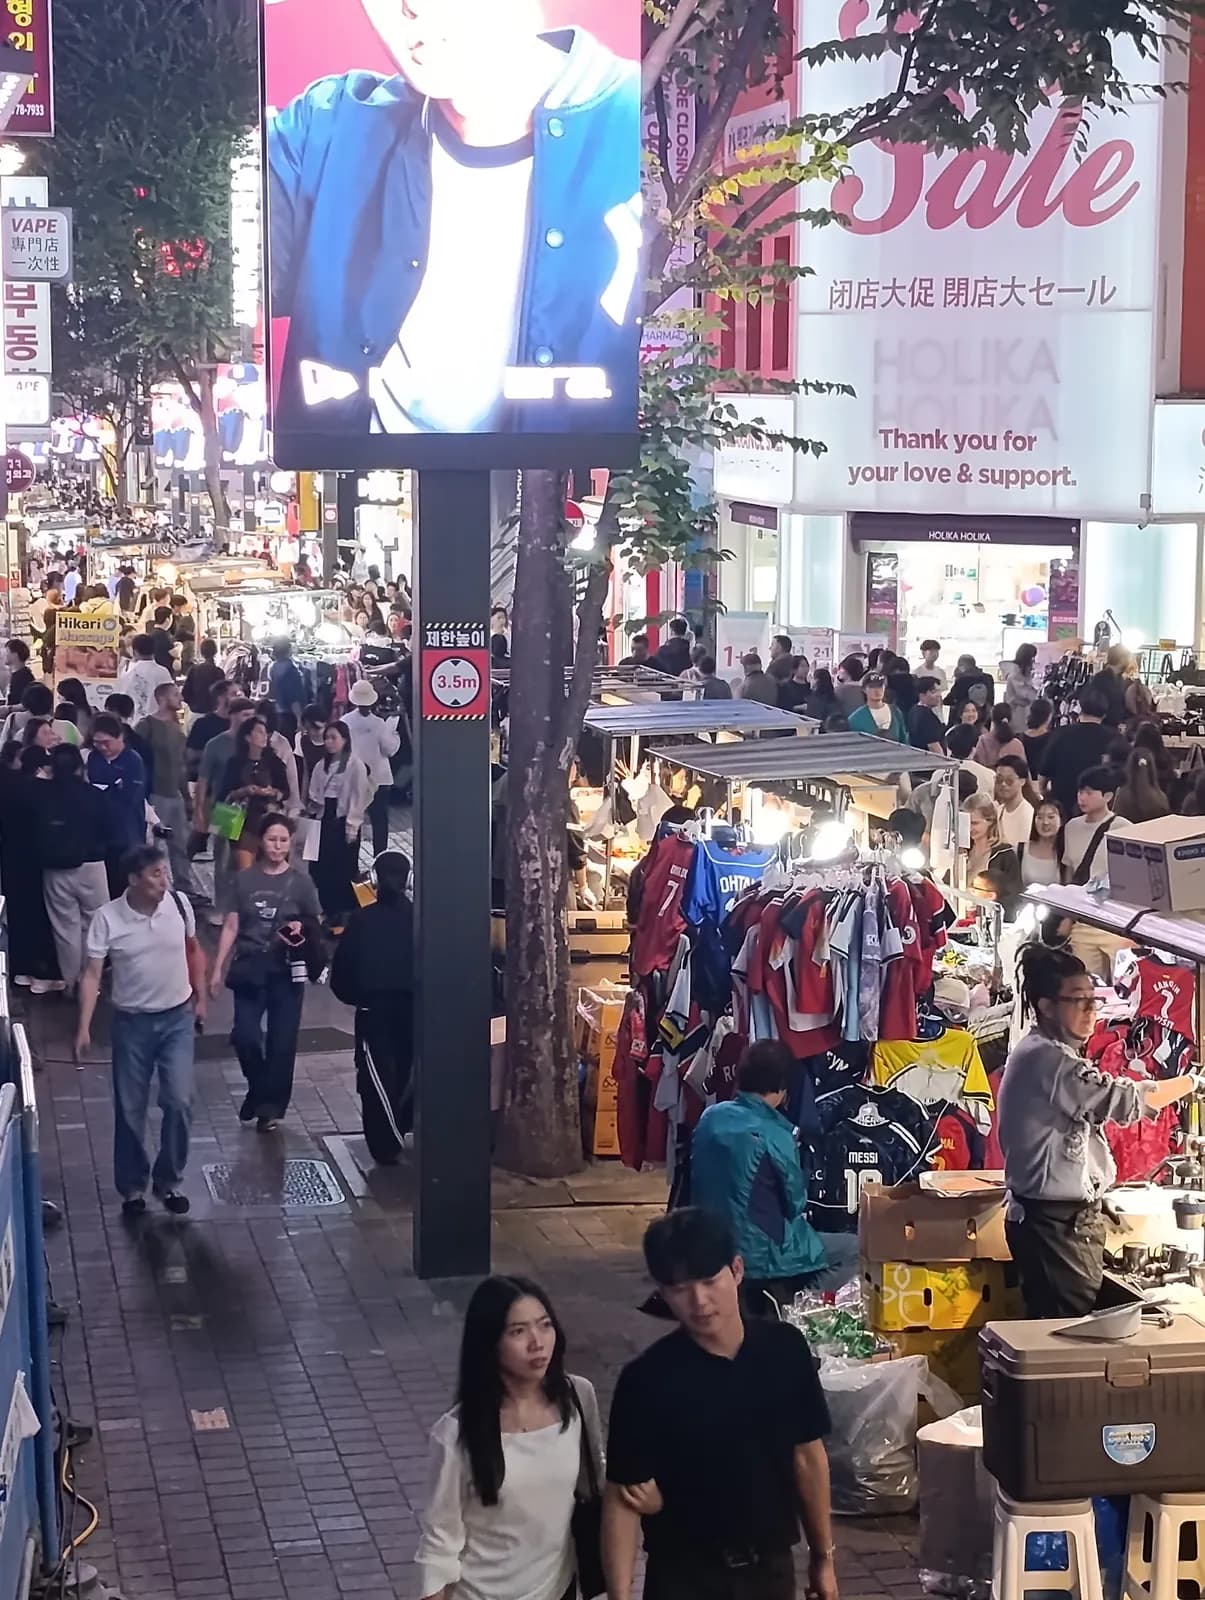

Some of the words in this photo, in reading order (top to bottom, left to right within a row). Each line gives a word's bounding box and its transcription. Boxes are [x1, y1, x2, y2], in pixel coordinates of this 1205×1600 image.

[12, 218, 57, 233] VAPE
[11, 237, 58, 252] 專門店
[11, 256, 60, 271] 一次性
[829, 276, 935, 310] 闭店大促
[942, 275, 1118, 308] 閉店大セール
[642, 331, 690, 341] HARMACY
[873, 337, 1061, 385] HOLIKA
[872, 393, 1060, 441] HOLIKA
[879, 428, 949, 450] Thank
[953, 433, 998, 455] you
[1002, 430, 1038, 452] for
[847, 464, 899, 486] your
[903, 461, 952, 484] love
[956, 463, 974, 484] &
[977, 465, 1078, 490] support.
[928, 531, 959, 541] HOLIKA
[960, 532, 991, 542] HOLIKA
[58, 617, 101, 630] Hikari
[426, 630, 485, 647] 제한높이
[437, 675, 477, 689] 3.5m
[658, 880, 680, 917] 7
[848, 1151, 878, 1164] MESSI
